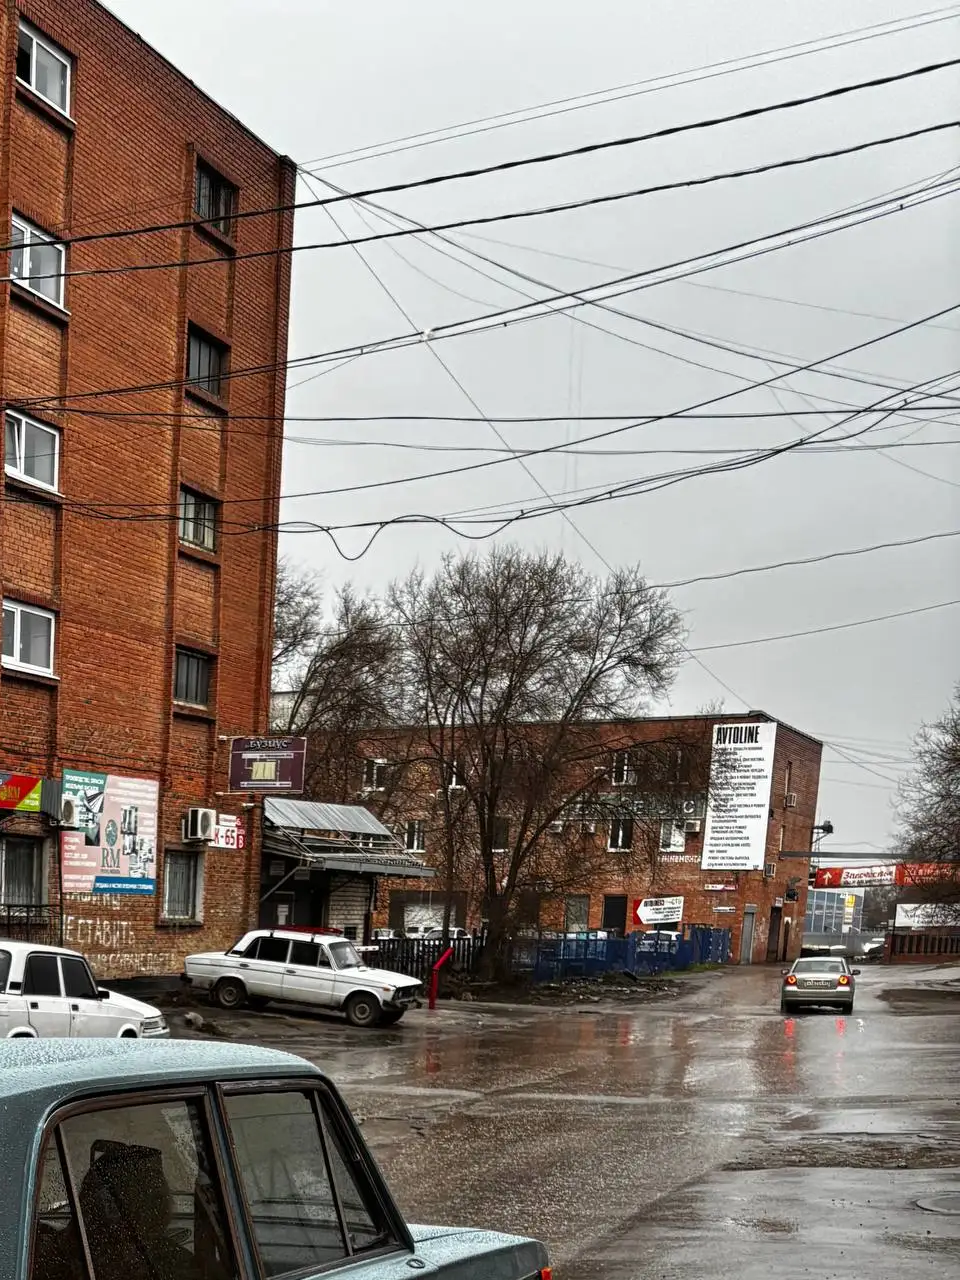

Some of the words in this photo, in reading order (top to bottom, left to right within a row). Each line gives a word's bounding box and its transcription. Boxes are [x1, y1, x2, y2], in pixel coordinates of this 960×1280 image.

[716, 726, 760, 744] AVTOLINE
[101, 847, 121, 869] RM
[77, 917, 136, 949] СТАВИТЬ
